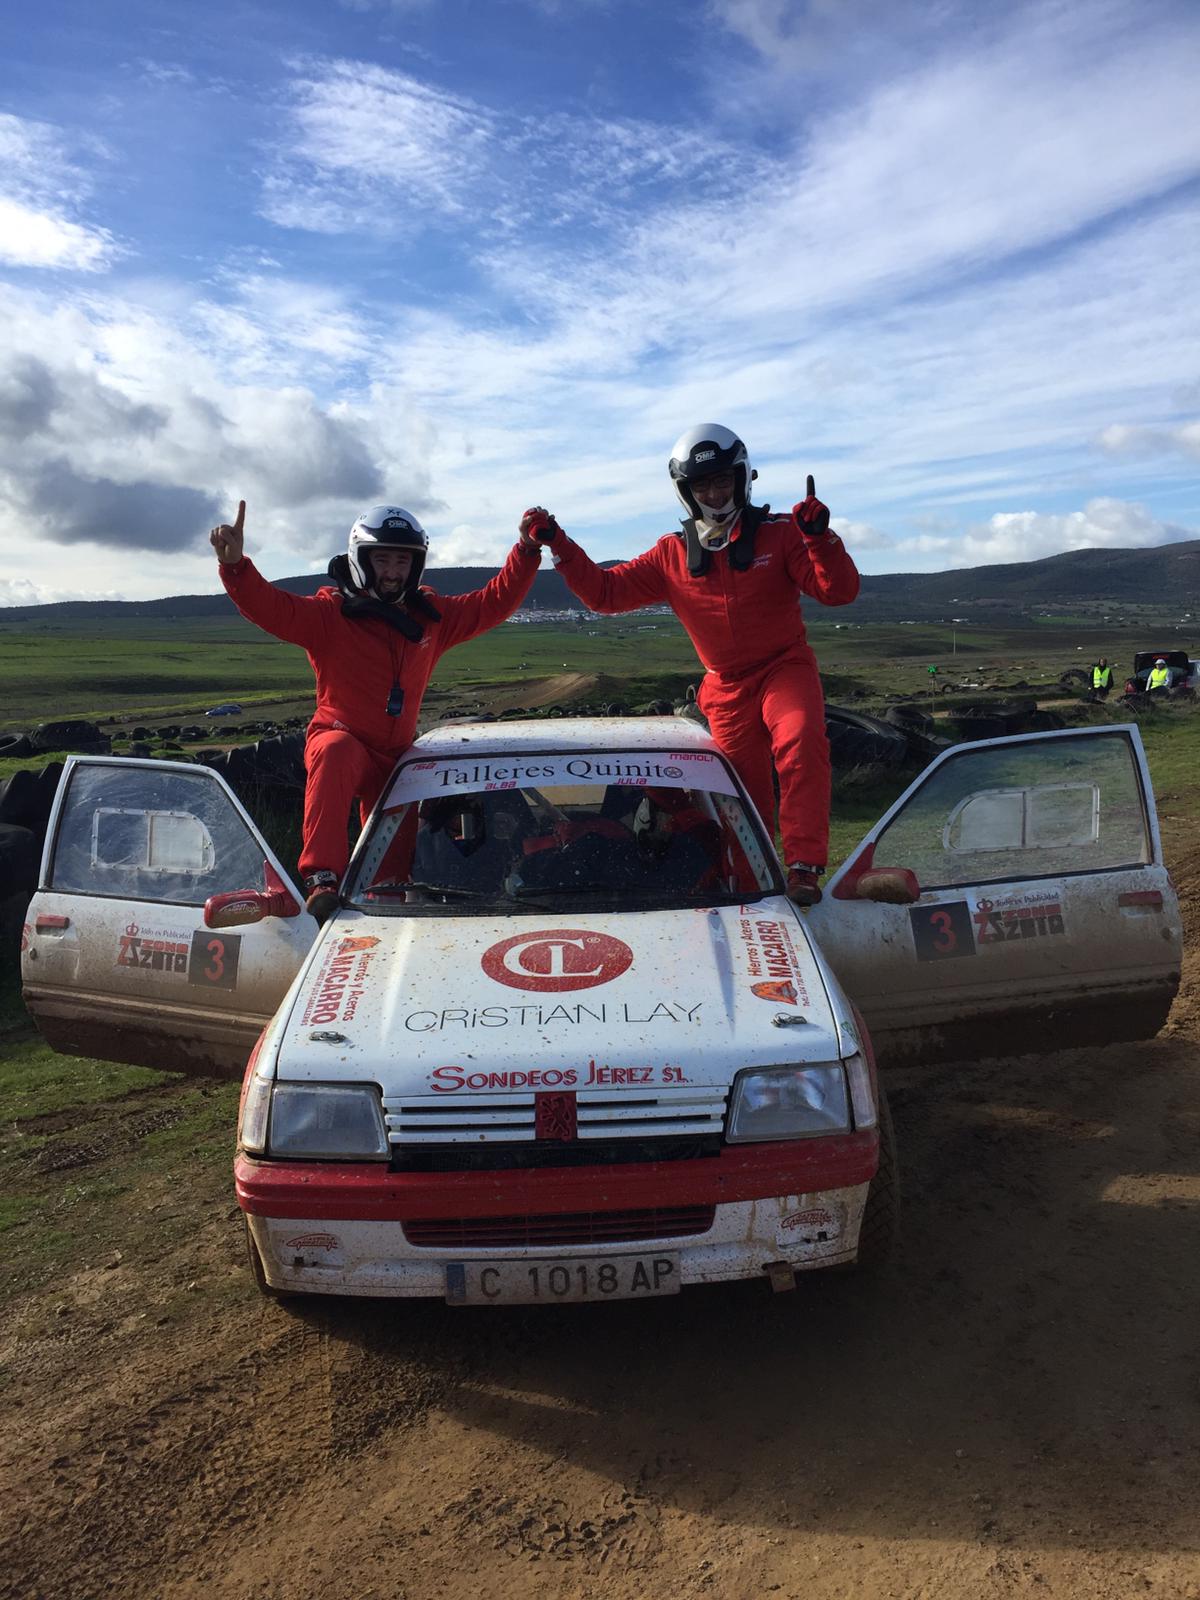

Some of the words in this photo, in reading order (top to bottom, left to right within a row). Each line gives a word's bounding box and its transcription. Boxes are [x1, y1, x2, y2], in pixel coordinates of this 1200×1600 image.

[435, 765, 555, 787] Talleres
[740, 919, 753, 941] Aceros
[930, 911, 957, 951] 3
[205, 939, 225, 981] 3
[747, 946, 762, 977] Hierros
[755, 920, 793, 978] MACARRO
[353, 952, 376, 982] Hierros
[310, 955, 355, 1025] MACARRO
[342, 990, 364, 1021] Aceros
[624, 1003, 702, 1022] LAY
[430, 1066, 577, 1092] SONDEOS
[584, 1059, 654, 1086] JEREZ
[480, 1267, 501, 1298] C
[528, 1263, 619, 1297] 1018
[630, 1258, 674, 1292] AP
